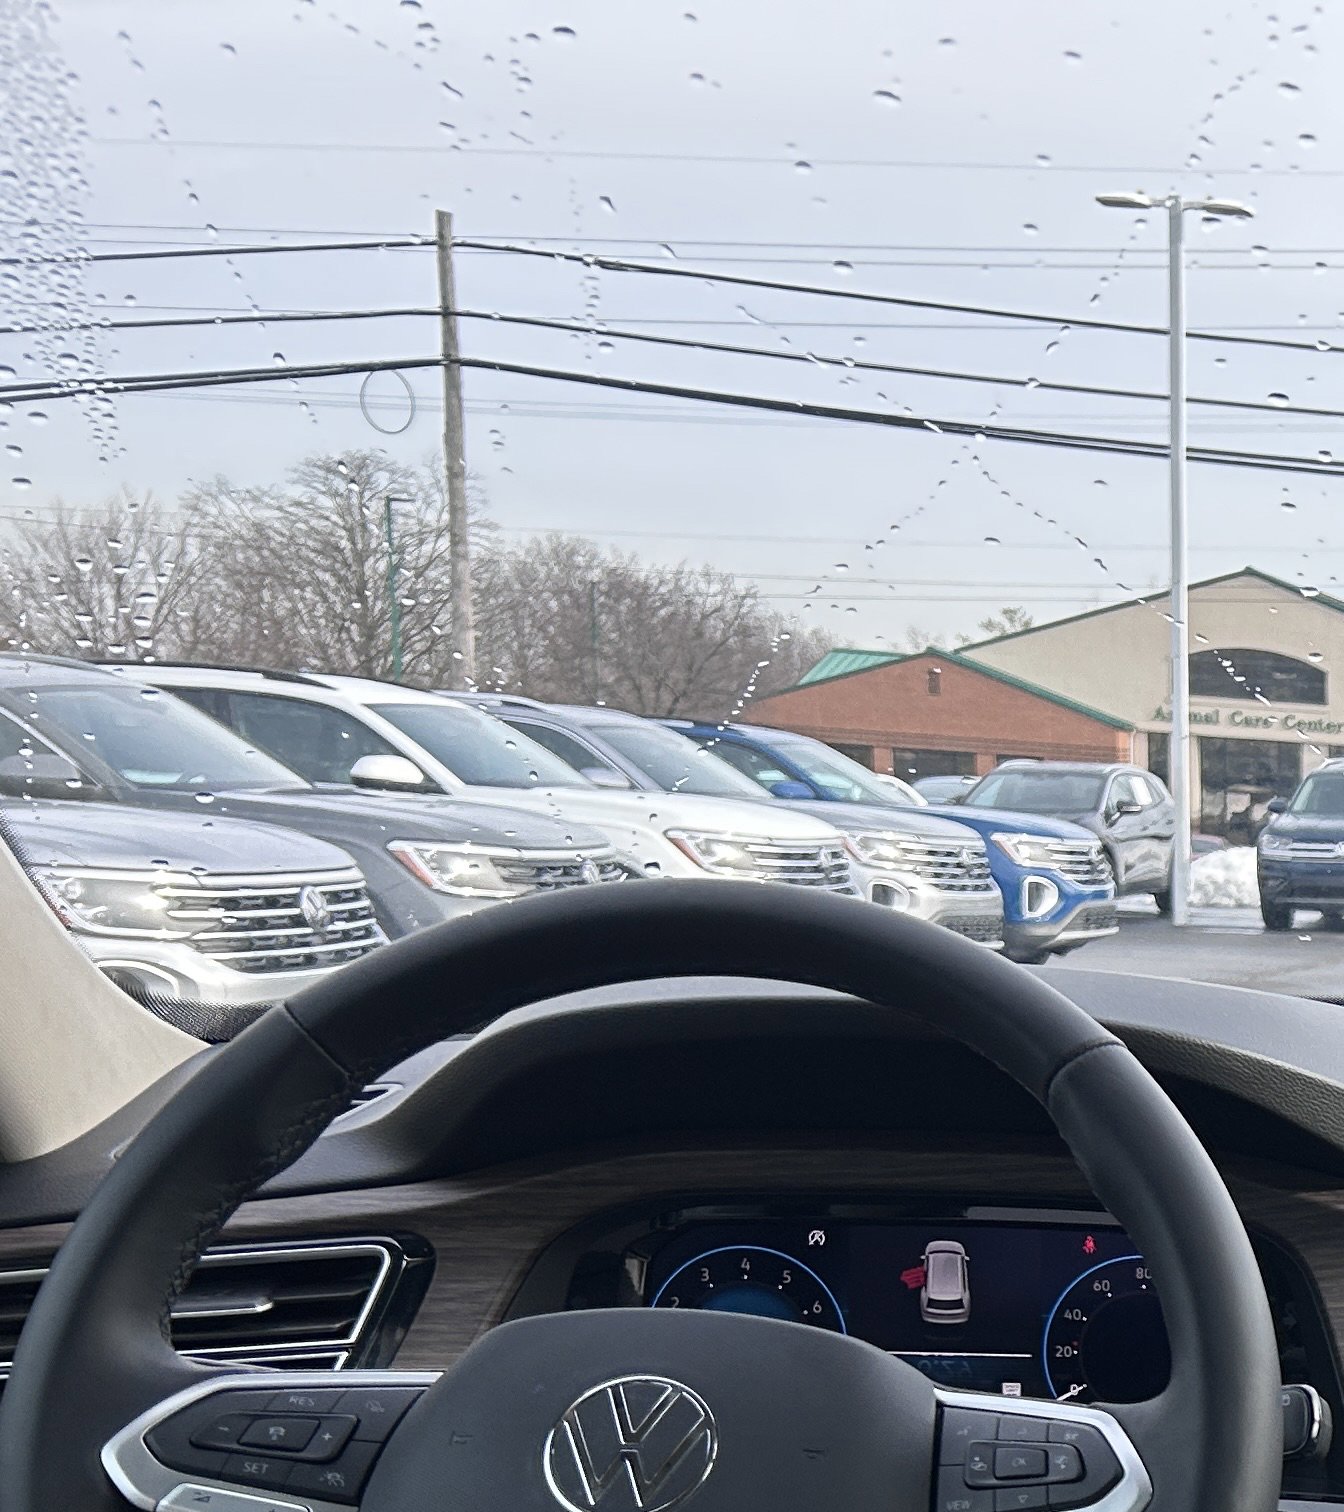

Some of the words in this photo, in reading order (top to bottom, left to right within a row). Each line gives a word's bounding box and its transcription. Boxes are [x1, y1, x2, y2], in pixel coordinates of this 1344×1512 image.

[1228, 711, 1277, 729] Care
[1282, 714, 1344, 735] Center
[741, 1258, 750, 1271] 4
[701, 1268, 710, 1281] 3
[783, 1270, 792, 1283] 5
[1093, 1280, 1110, 1292] 60
[813, 1301, 822, 1314] 6
[1064, 1309, 1081, 1321] 40
[1055, 1346, 1072, 1358] 20
[289, 1396, 315, 1406] RES
[243, 1462, 269, 1474] SET
[946, 1500, 971, 1511] VIEW
